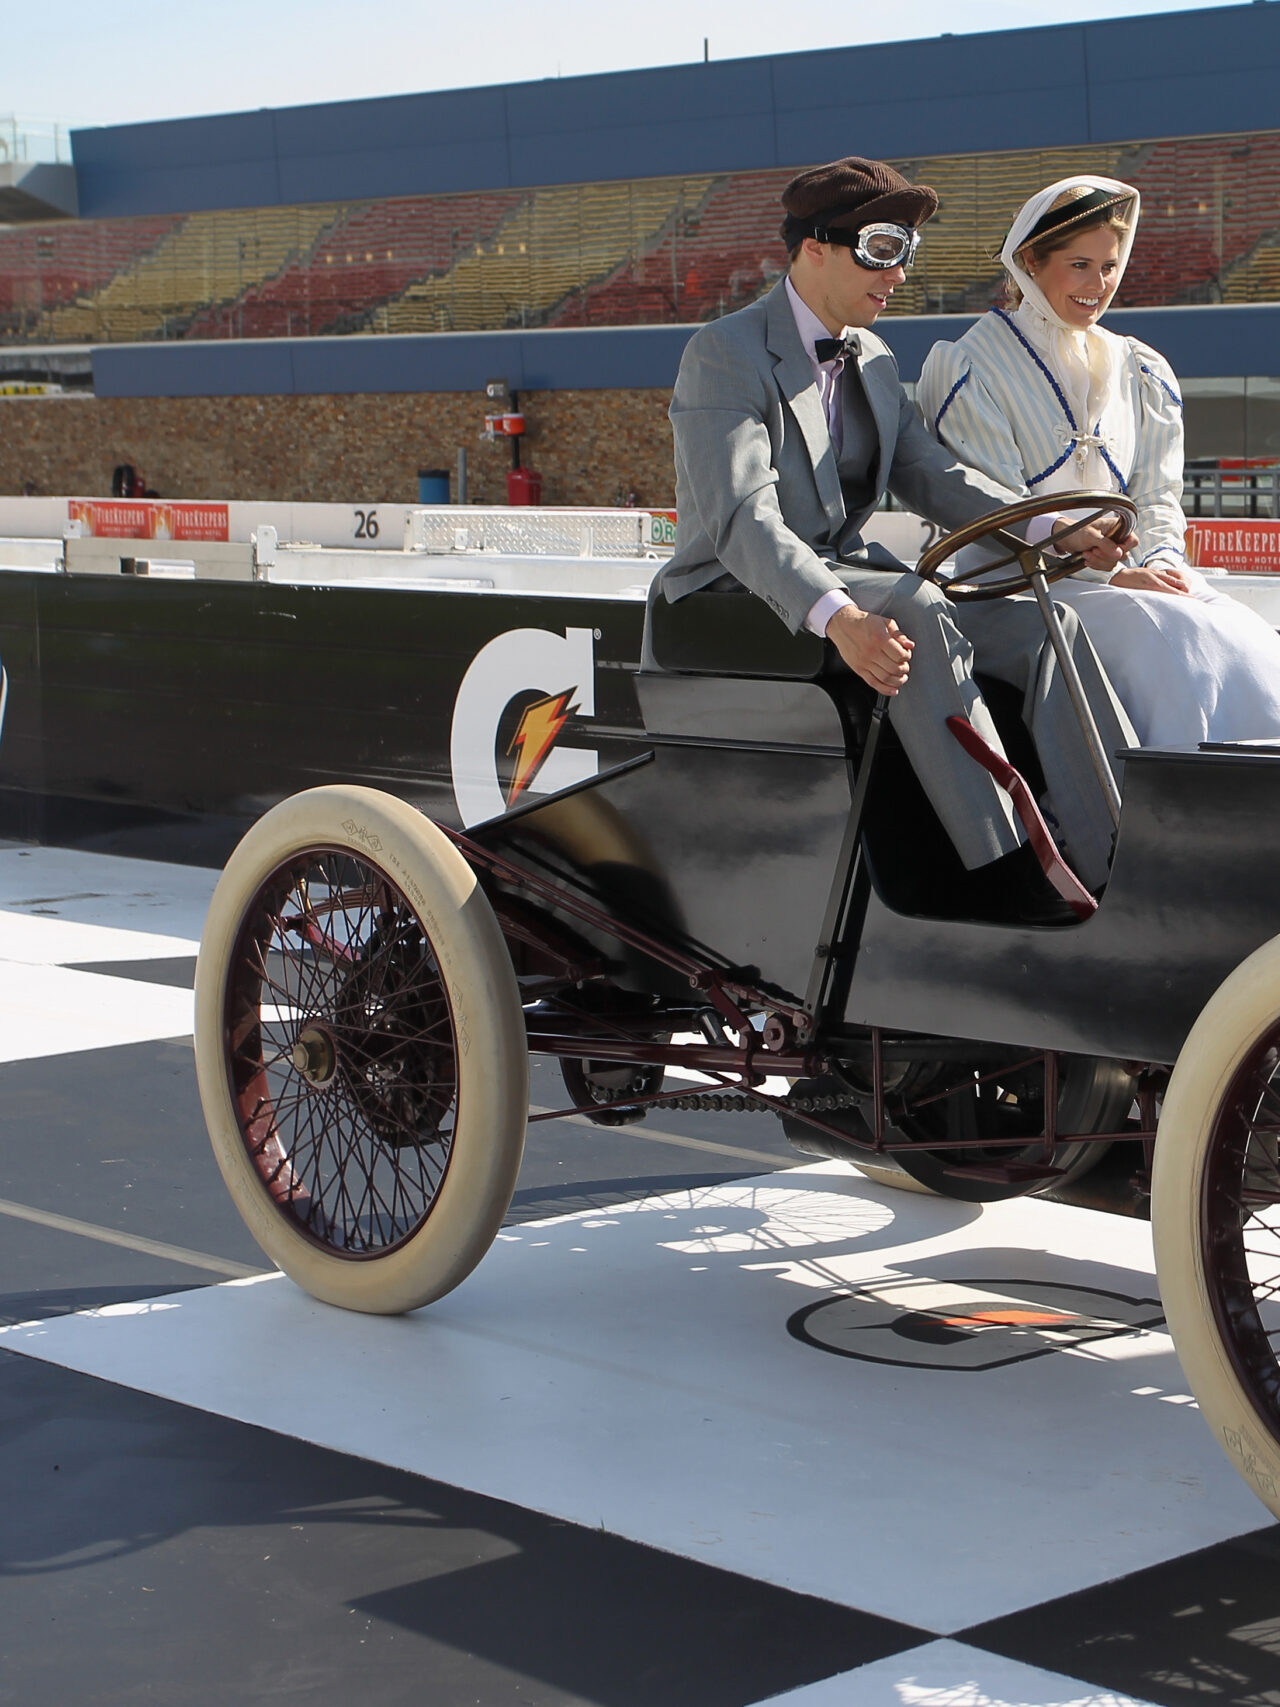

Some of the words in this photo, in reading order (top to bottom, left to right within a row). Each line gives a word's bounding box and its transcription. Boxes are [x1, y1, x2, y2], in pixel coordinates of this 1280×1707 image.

[354, 510, 379, 539] 26
[651, 516, 676, 543] O'R
[1213, 555, 1247, 564] CASINO
